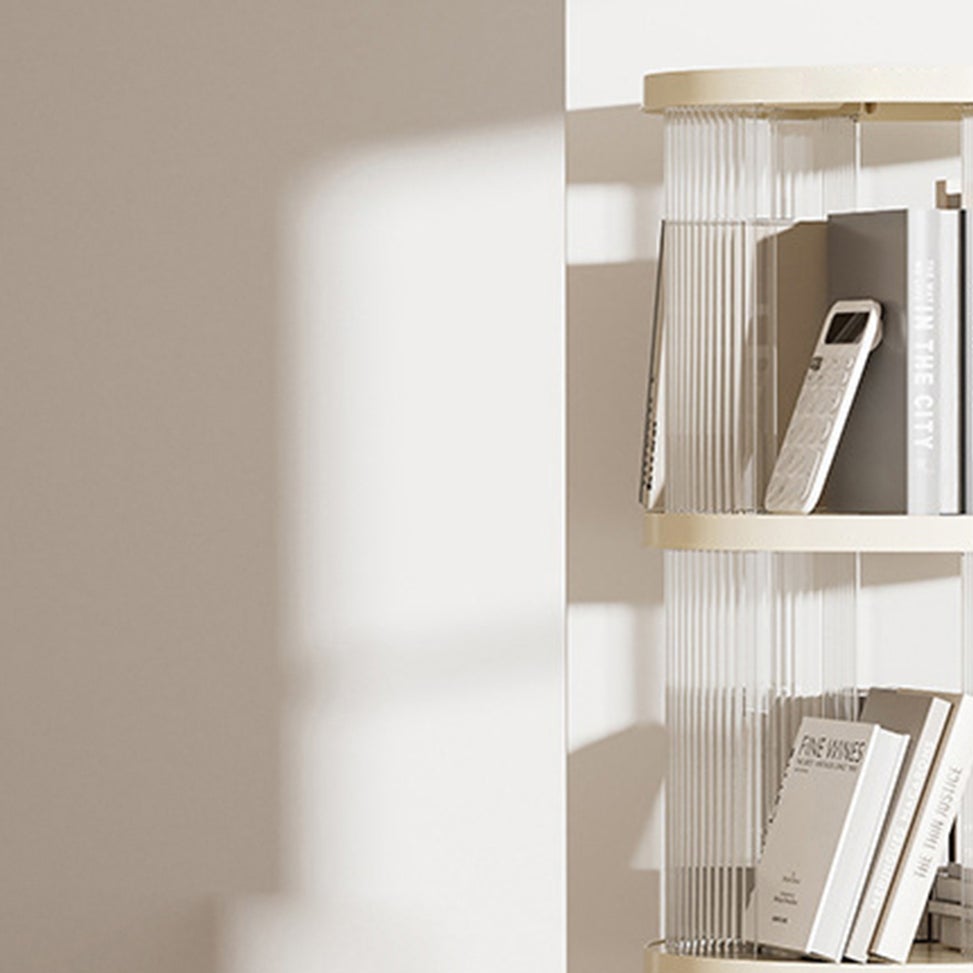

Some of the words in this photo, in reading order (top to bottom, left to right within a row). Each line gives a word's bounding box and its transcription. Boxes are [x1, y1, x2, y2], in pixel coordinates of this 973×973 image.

[913, 305, 934, 330] IN
[913, 339, 934, 385] THE
[913, 394, 934, 450] CITY
[798, 735, 828, 759] FINE
[826, 738, 866, 763] WINES
[913, 852, 932, 878] THE
[934, 764, 963, 818] JUSTICE
